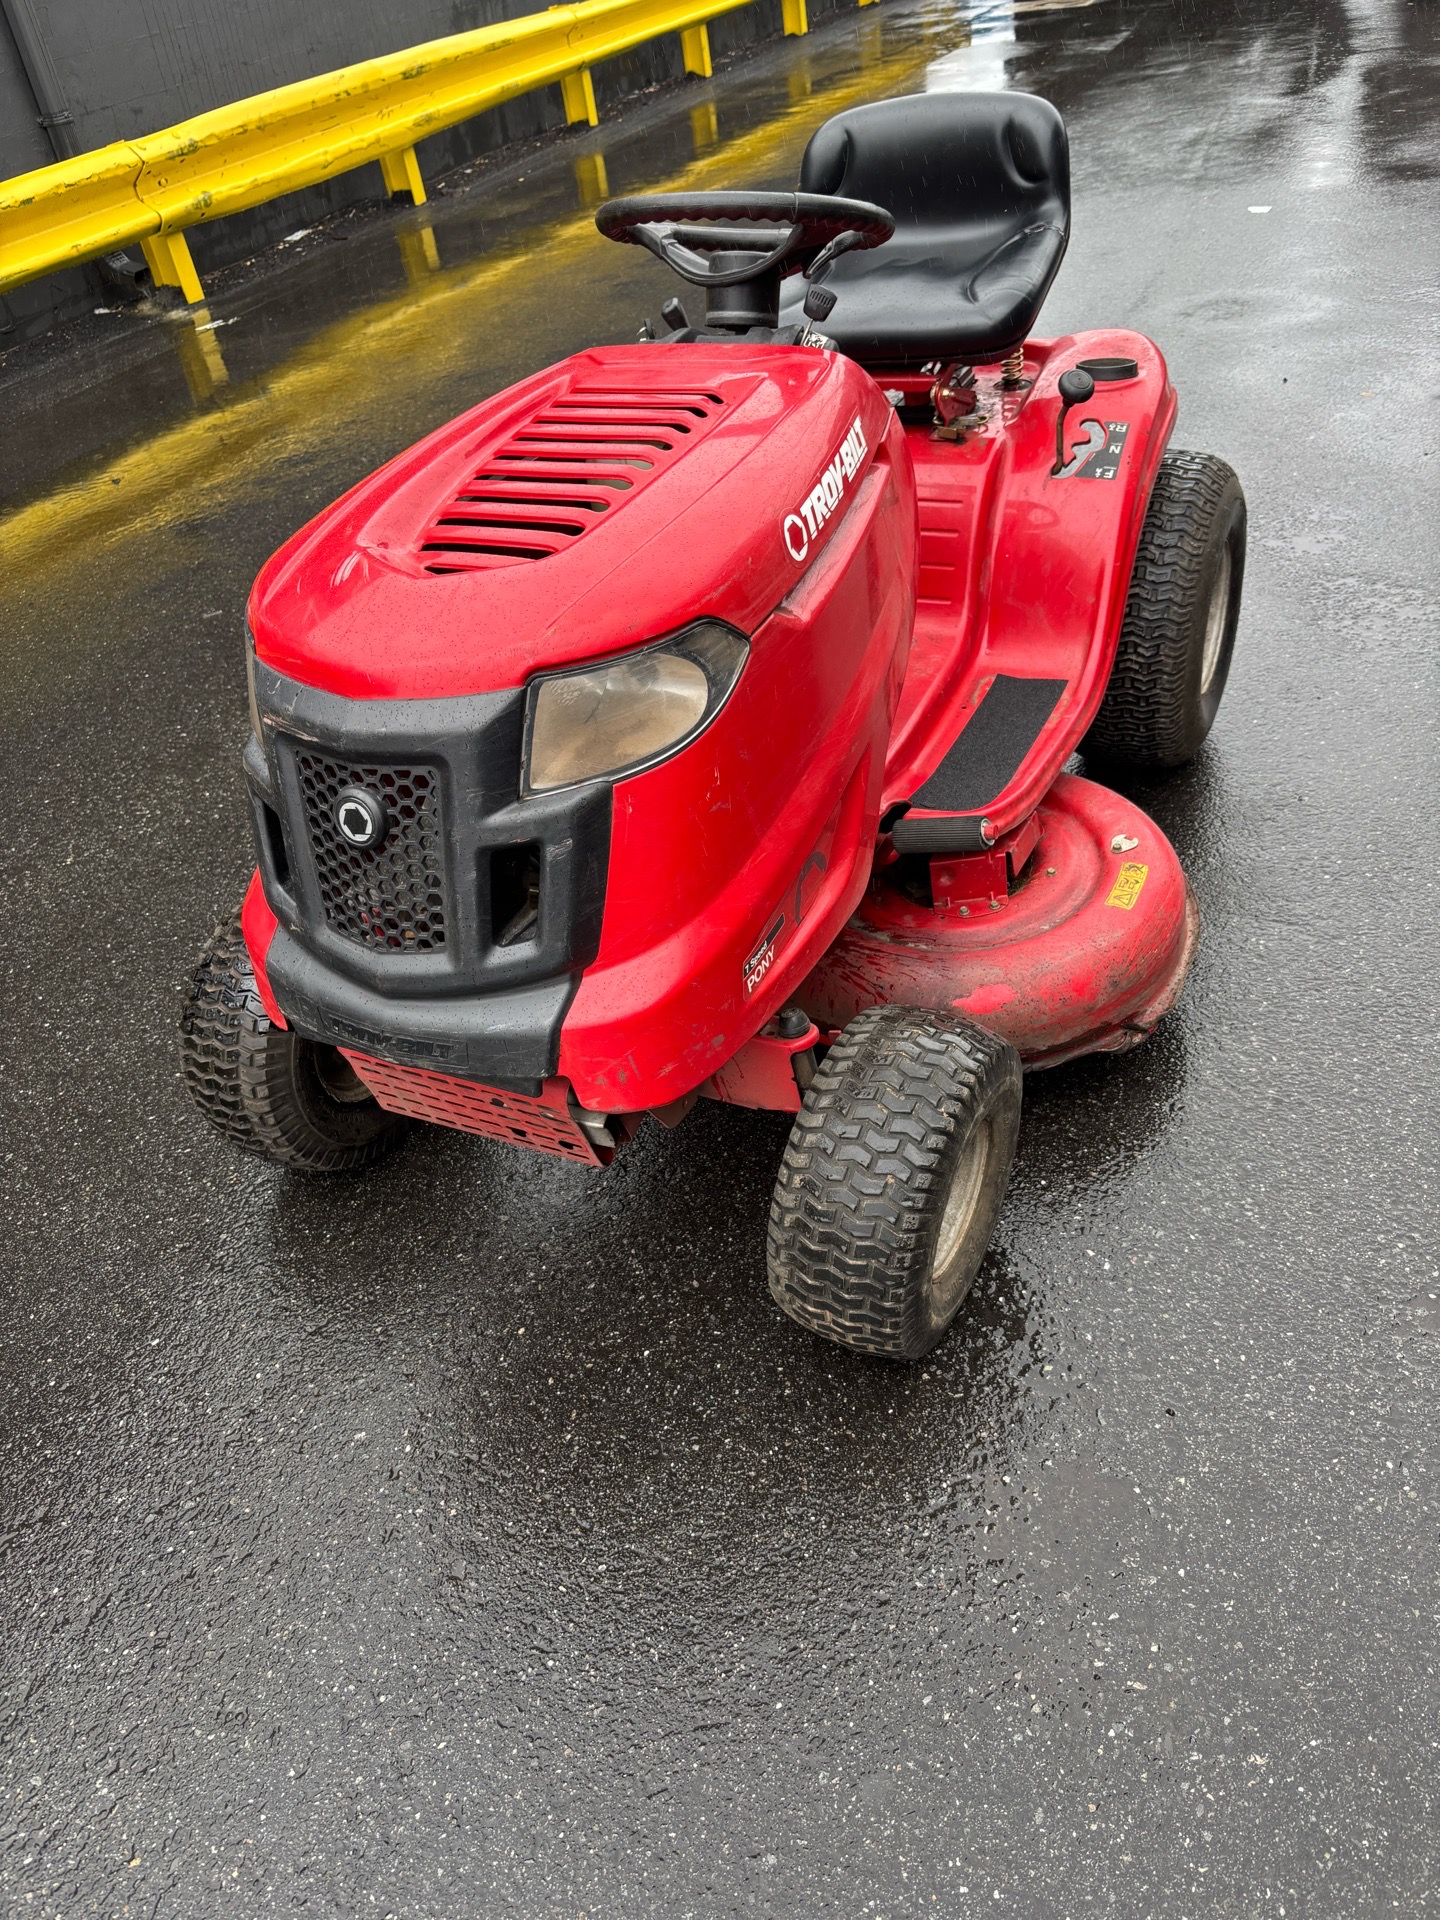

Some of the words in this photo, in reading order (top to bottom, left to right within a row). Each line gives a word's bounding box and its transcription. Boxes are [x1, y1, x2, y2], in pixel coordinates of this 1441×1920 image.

[1115, 424, 1128, 433] R
[1108, 445, 1122, 454] N
[799, 414, 869, 541] TROY-BILT
[1103, 469, 1115, 479] F
[749, 939, 768, 968] Speed
[746, 944, 775, 993] PONY
